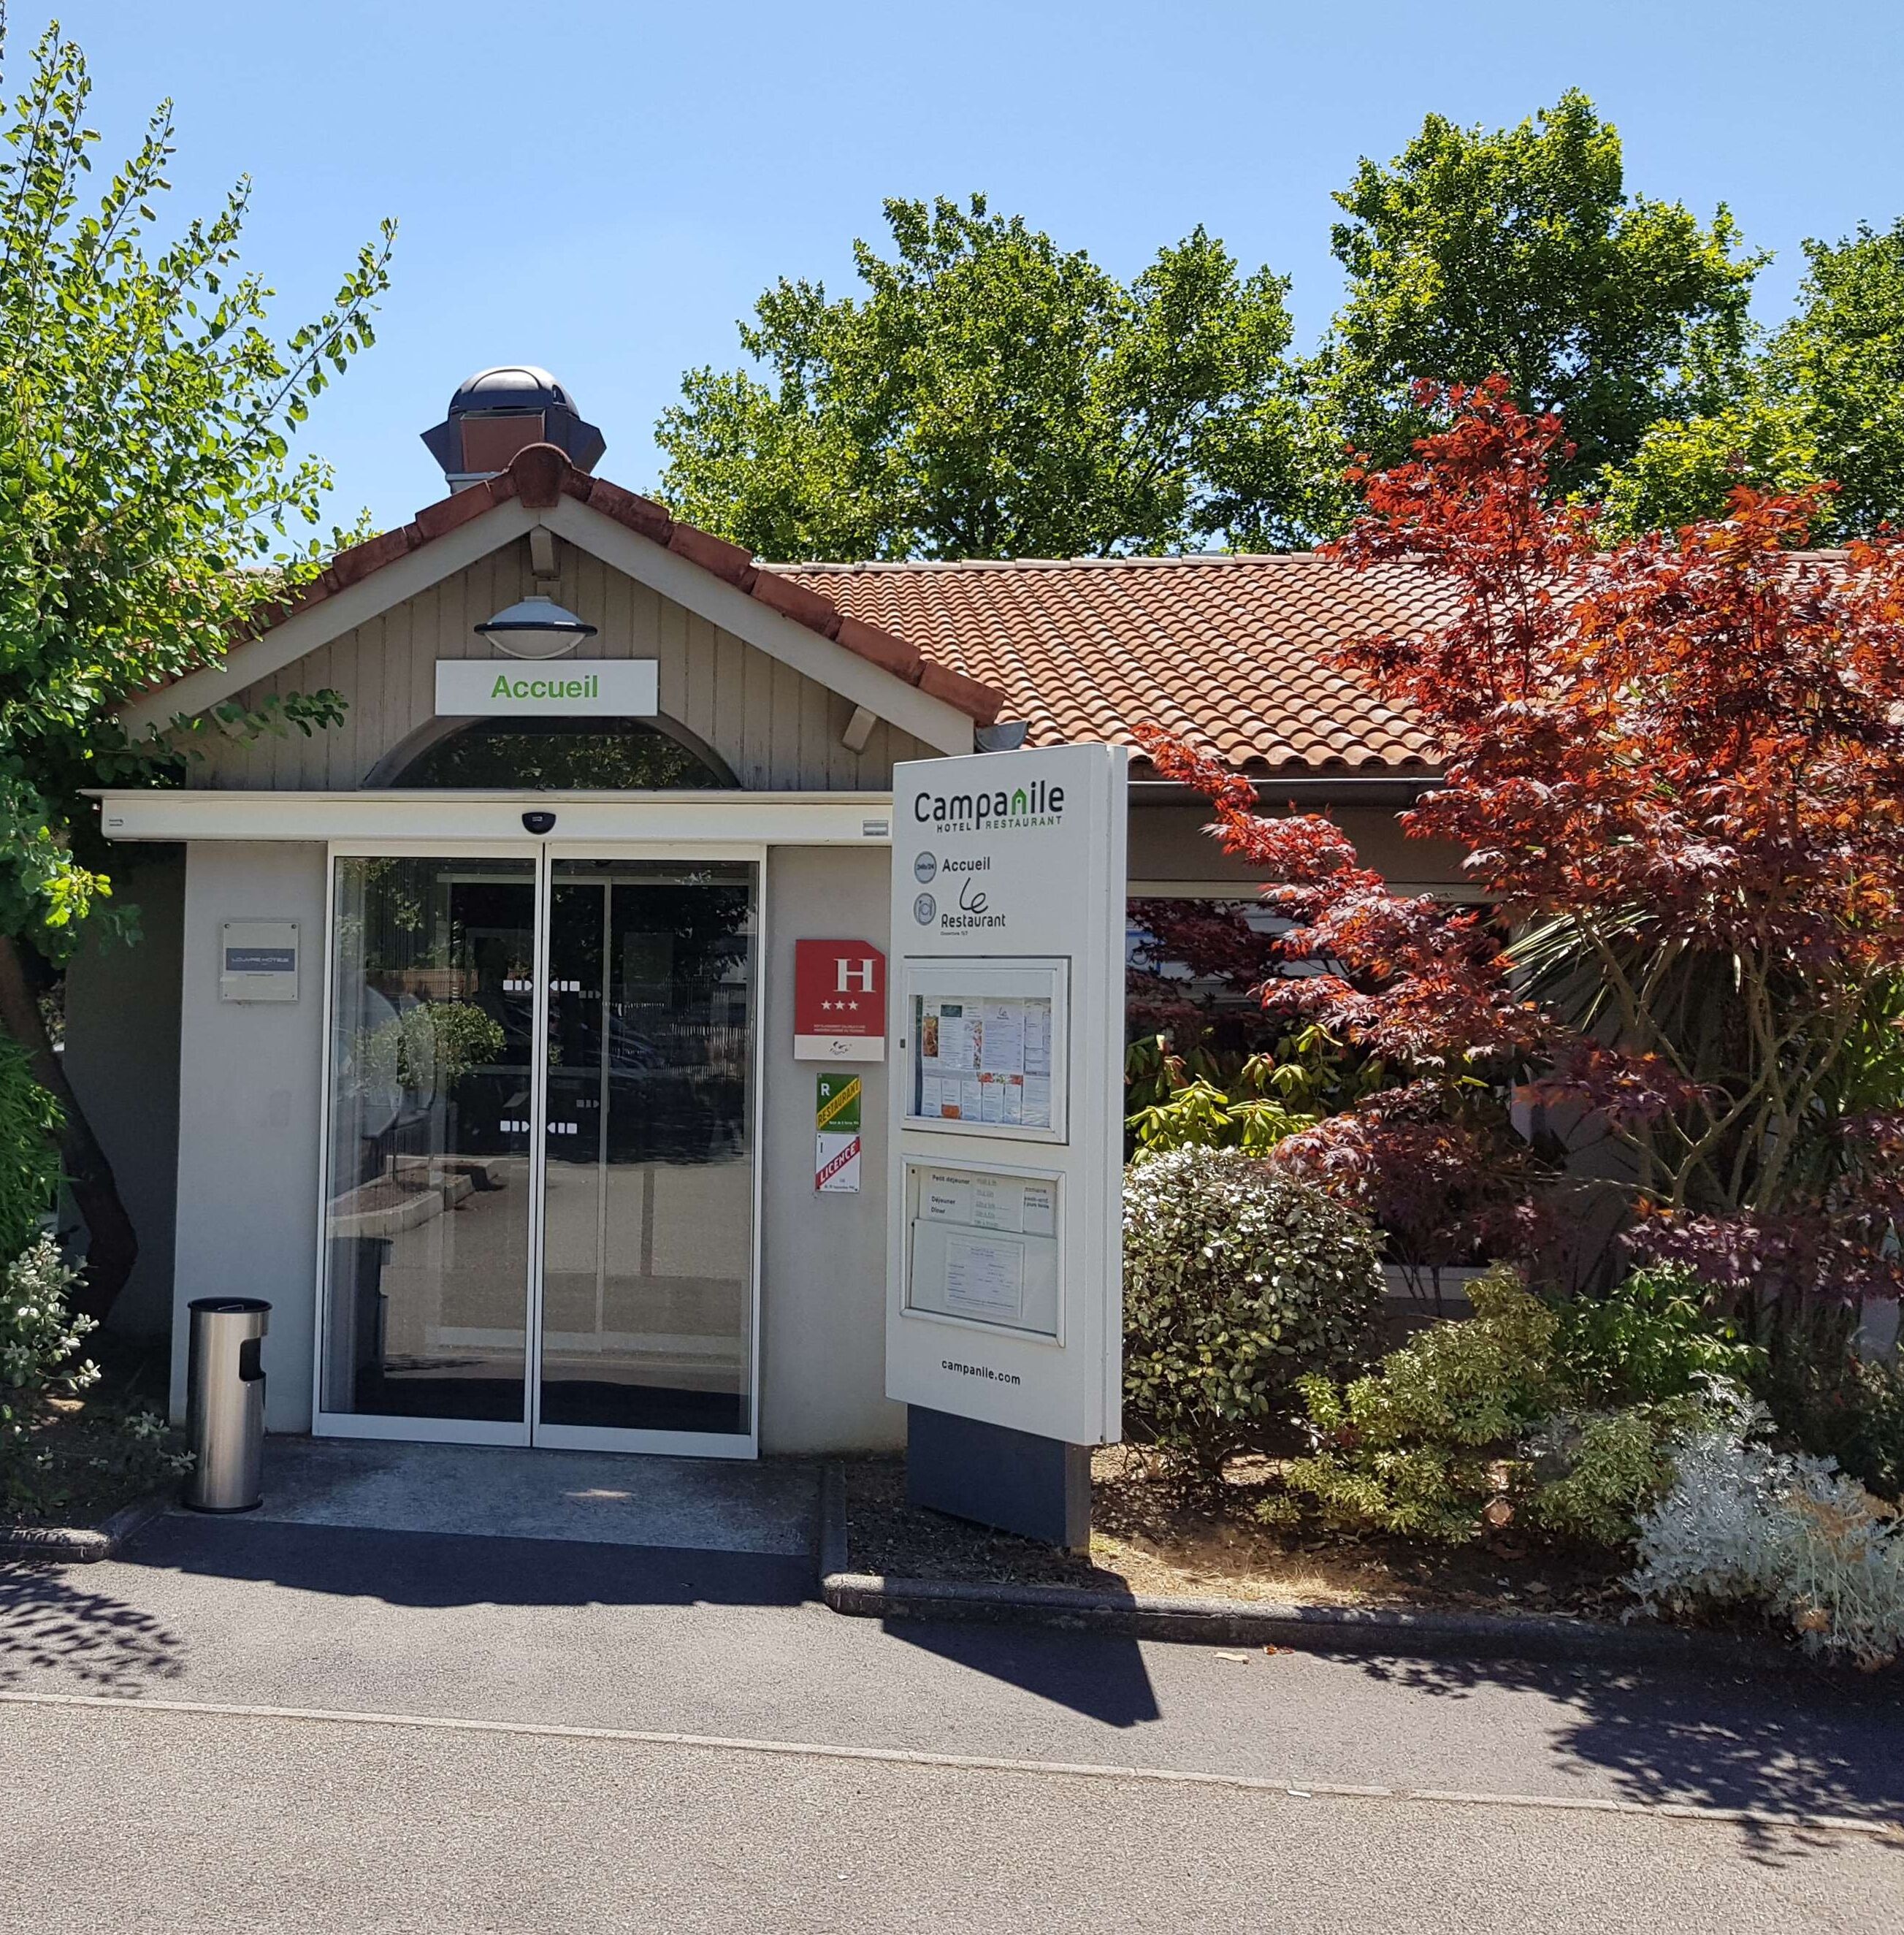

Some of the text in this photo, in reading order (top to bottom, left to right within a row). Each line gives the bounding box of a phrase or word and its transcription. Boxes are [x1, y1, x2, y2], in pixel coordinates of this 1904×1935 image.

[491, 675, 598, 698] Accueil
[914, 780, 1064, 830] Campanile
[937, 816, 1062, 833] HOTEL RESTAURANT
[942, 856, 990, 872] Accueil
[941, 914, 1006, 928] Restaurant
[833, 958, 876, 993] H
[821, 1083, 830, 1096] R
[818, 1082, 859, 1123] RESTAURANT
[820, 1142, 857, 1183] LICENCE
[941, 1360, 1020, 1385] campanile.com
